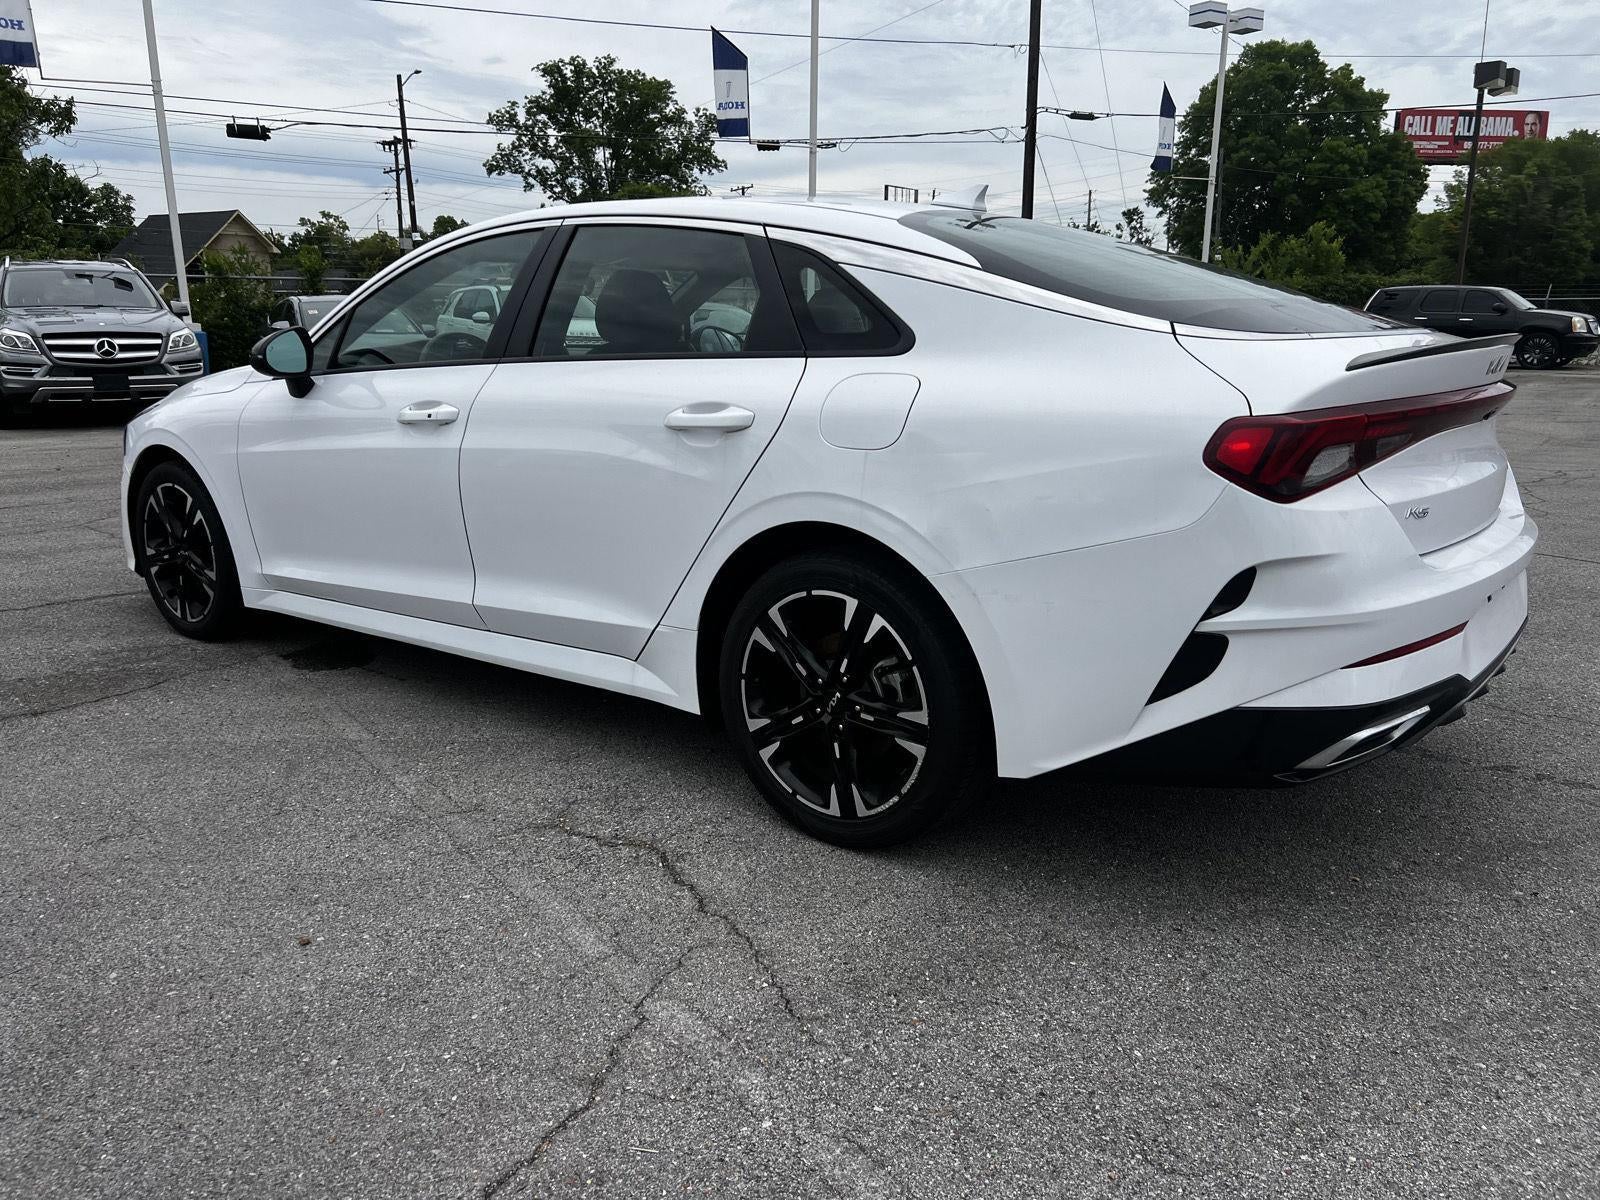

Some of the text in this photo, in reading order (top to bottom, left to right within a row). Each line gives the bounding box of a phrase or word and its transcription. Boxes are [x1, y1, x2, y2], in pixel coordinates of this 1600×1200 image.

[1404, 115, 1433, 136] CALL
[1435, 115, 1455, 136] ME
[1404, 506, 1430, 519] K5
